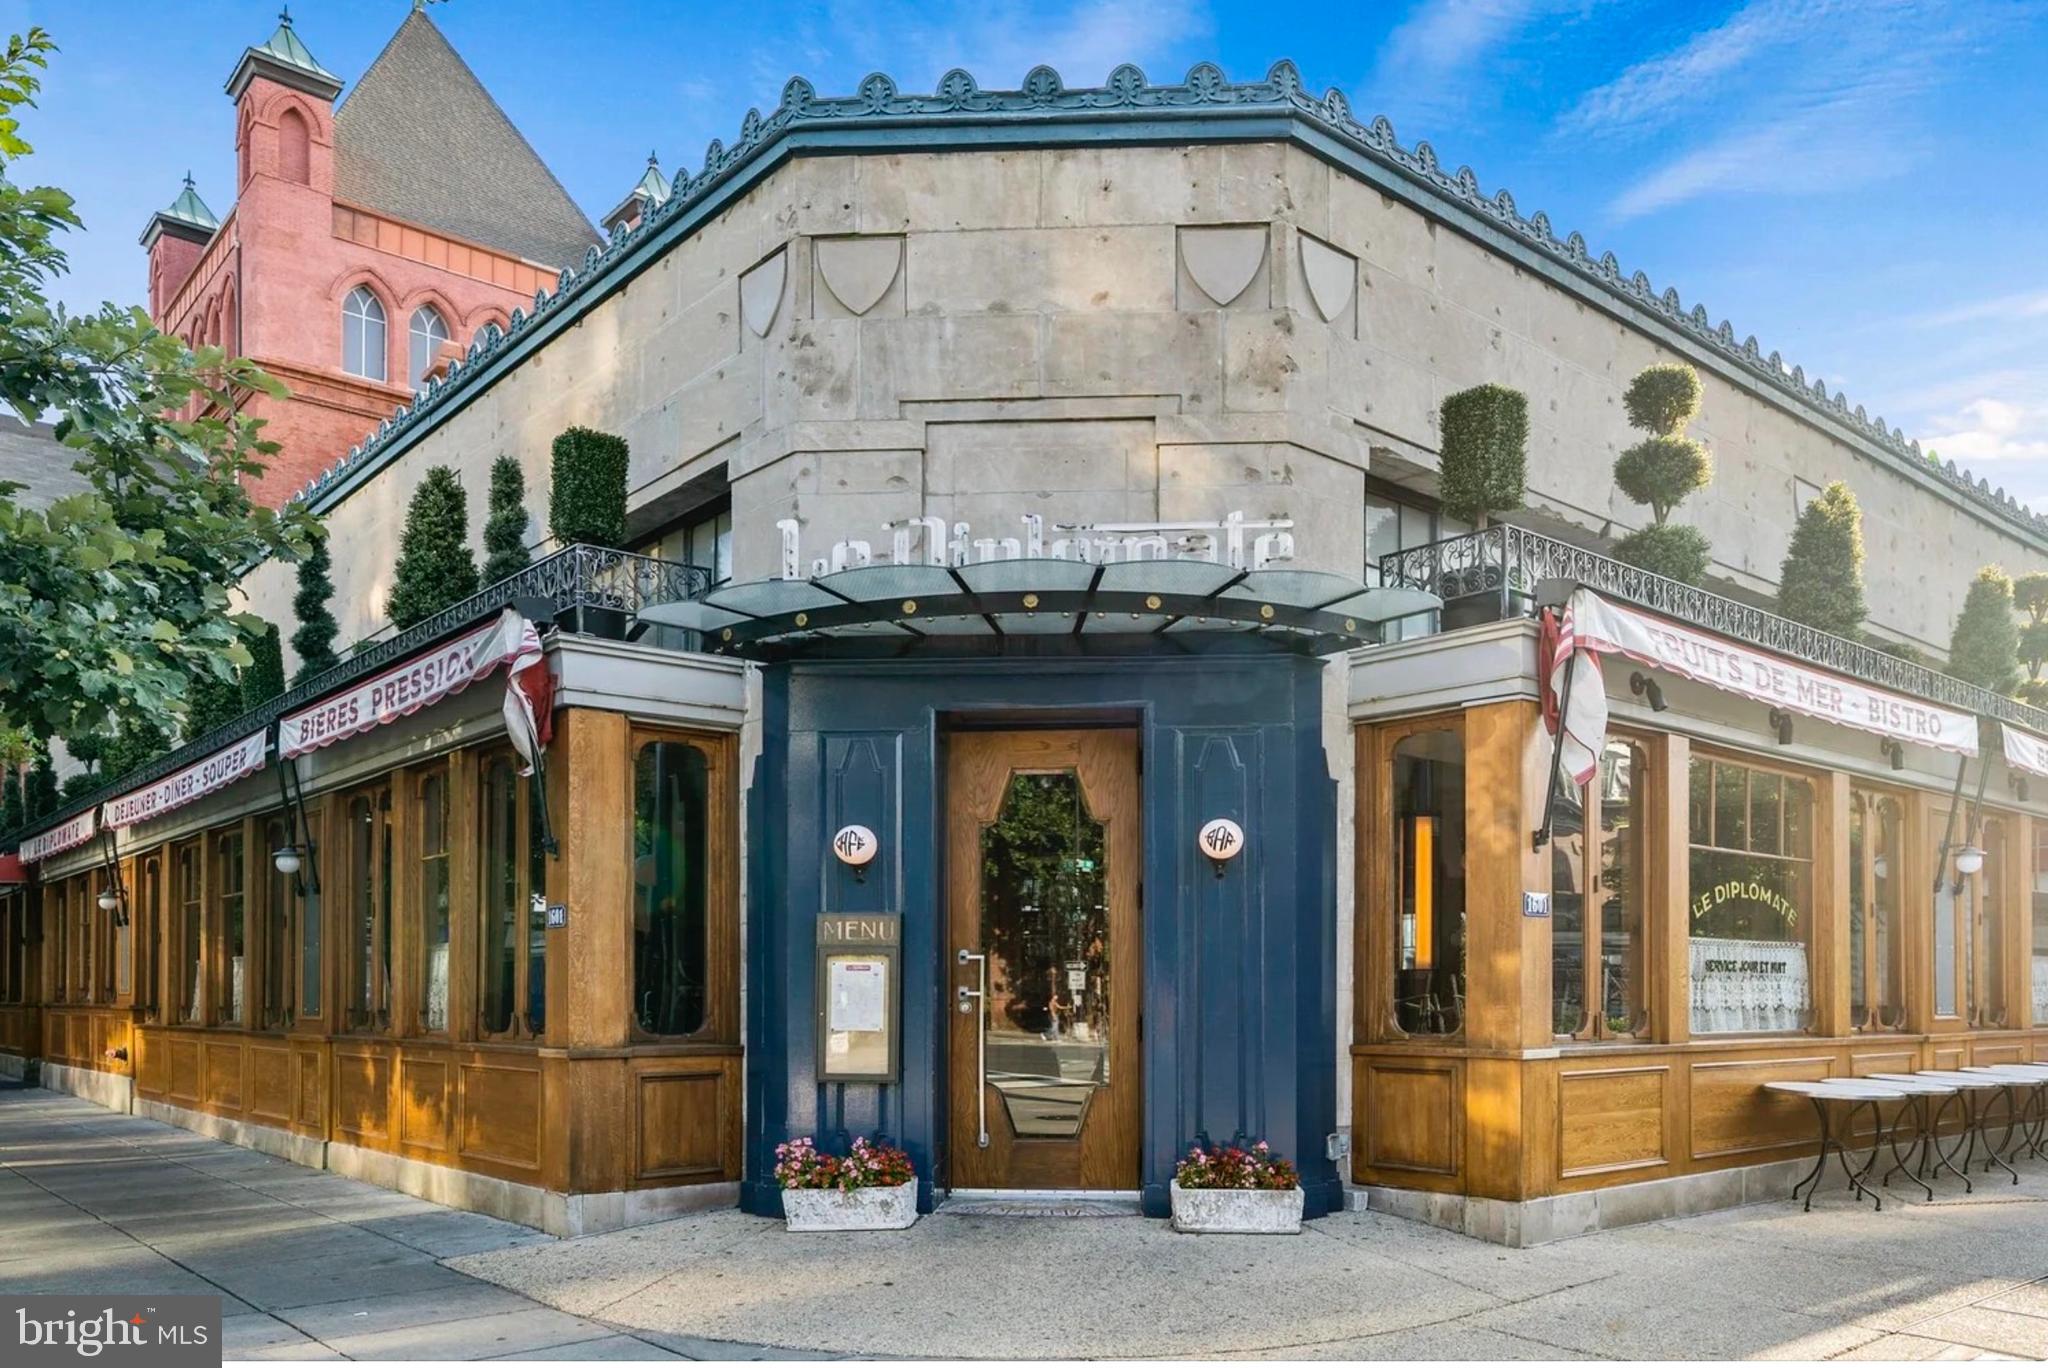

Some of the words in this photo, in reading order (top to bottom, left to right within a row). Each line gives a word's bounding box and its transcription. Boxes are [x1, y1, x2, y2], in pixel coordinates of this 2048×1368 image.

[1754, 661, 1787, 696] DE
[1797, 674, 1843, 714] MER
[1868, 695, 1942, 738] BISTRO
[300, 697, 359, 744] BIÈRES
[203, 747, 248, 787] SOUPER
[1205, 826, 1236, 851] BAR
[1693, 892, 1713, 919] LE
[1714, 880, 1798, 927] DIPLOMATE
[823, 920, 895, 940] MENU
[1760, 961, 1769, 974] ET
